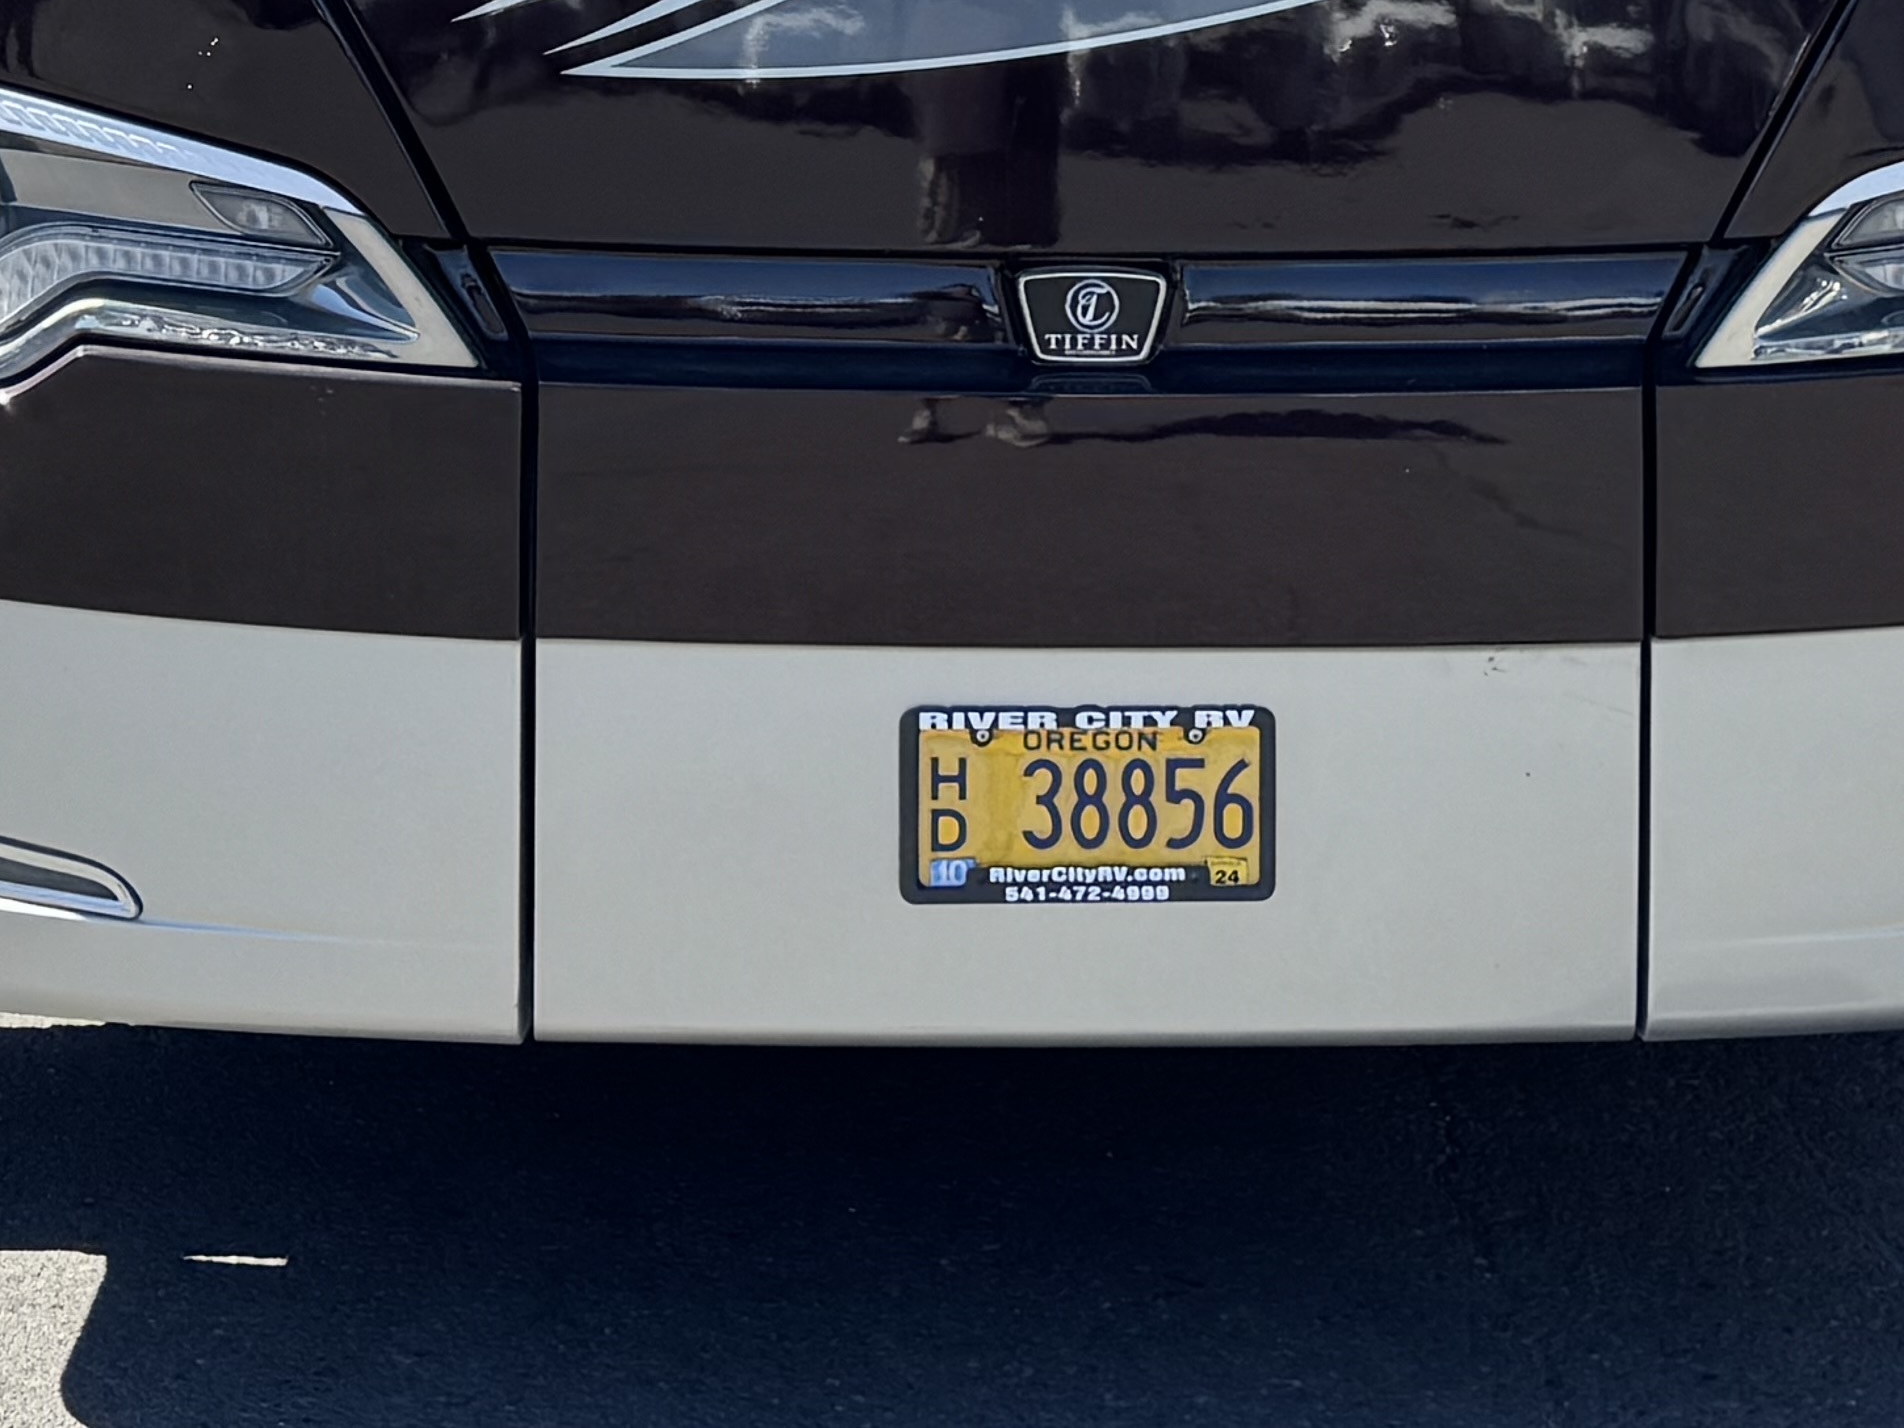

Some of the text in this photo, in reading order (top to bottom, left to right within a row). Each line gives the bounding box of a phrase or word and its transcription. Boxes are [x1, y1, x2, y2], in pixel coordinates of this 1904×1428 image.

[1044, 333, 1139, 350] TIFFIN
[919, 709, 1256, 730] RIVER CITY RV
[1023, 730, 1158, 752] OREGON
[1021, 757, 1254, 850] 38856
[989, 866, 1186, 884] RiverCityRV.com
[1215, 869, 1240, 884] 24
